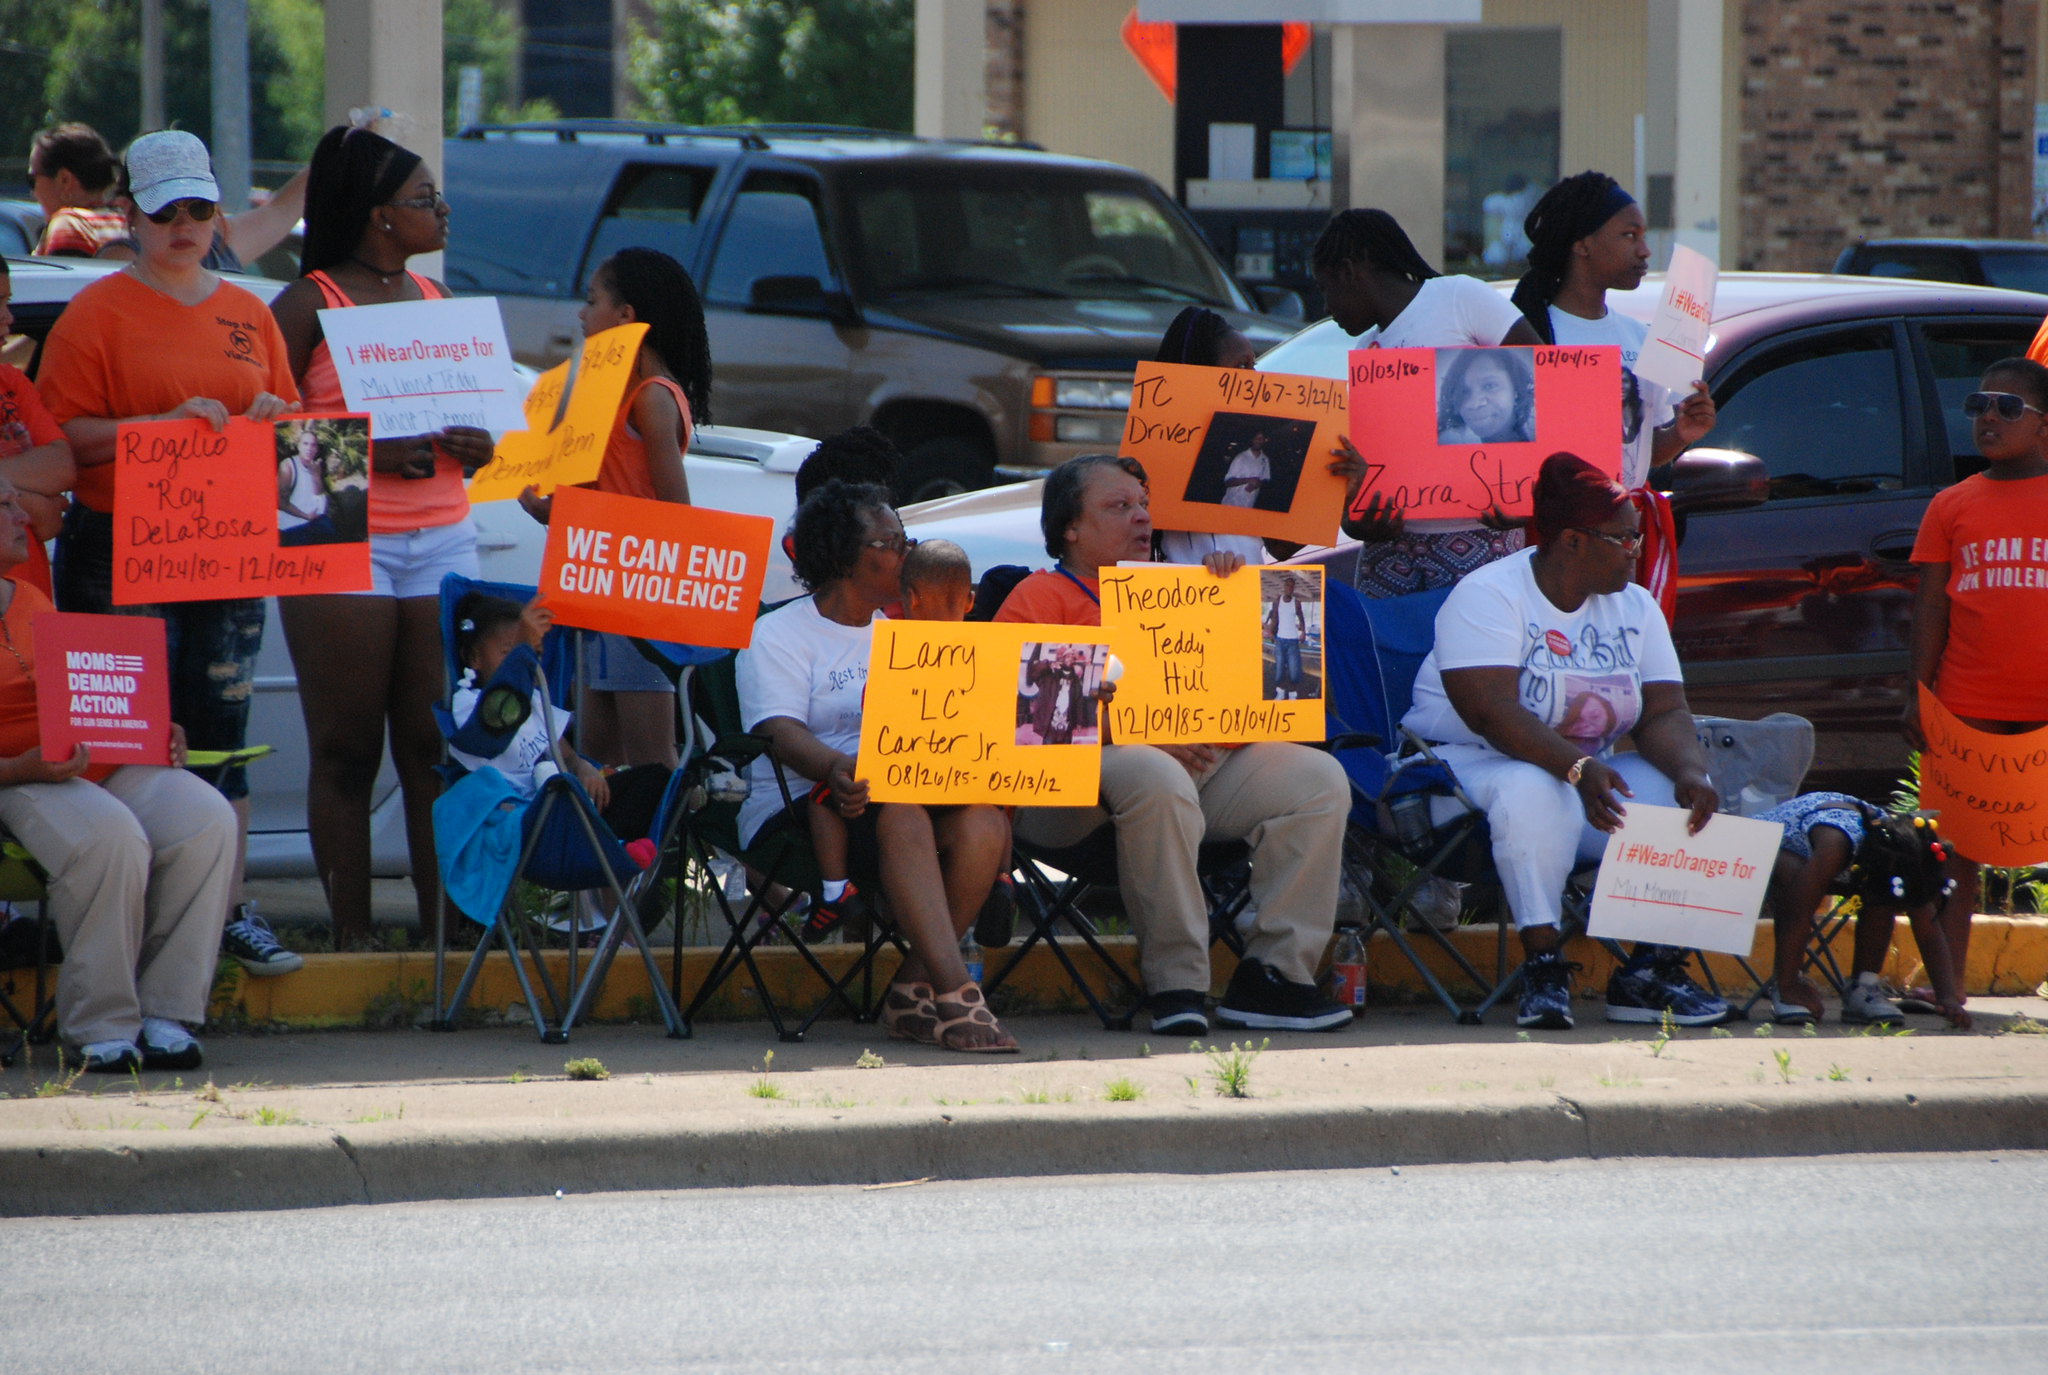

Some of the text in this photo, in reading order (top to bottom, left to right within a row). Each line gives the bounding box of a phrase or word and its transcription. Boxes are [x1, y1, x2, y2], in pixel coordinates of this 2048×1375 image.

[346, 336, 495, 365] I #WearOrange for
[1134, 375, 1172, 408] TC
[1129, 415, 1202, 444] Driver
[122, 430, 229, 478] Rogelio
[1467, 450, 1536, 511] Str
[131, 515, 268, 547] DeLaRosa
[566, 526, 748, 582] WE CAN END
[1985, 536, 2023, 562] CAN
[559, 563, 743, 612] GUN VIOLENCE
[1102, 574, 1225, 613] Theodore
[1986, 567, 2048, 589] VIOLEN
[66, 651, 116, 671] MOMS
[889, 631, 976, 693] Larry
[68, 673, 137, 694] DEMAND
[70, 694, 130, 714] ACTION
[878, 725, 969, 755] Carter
[1930, 703, 2048, 774] Survivo
[1616, 842, 1757, 880] I #WearOrange for
[1612, 876, 1638, 908] My
